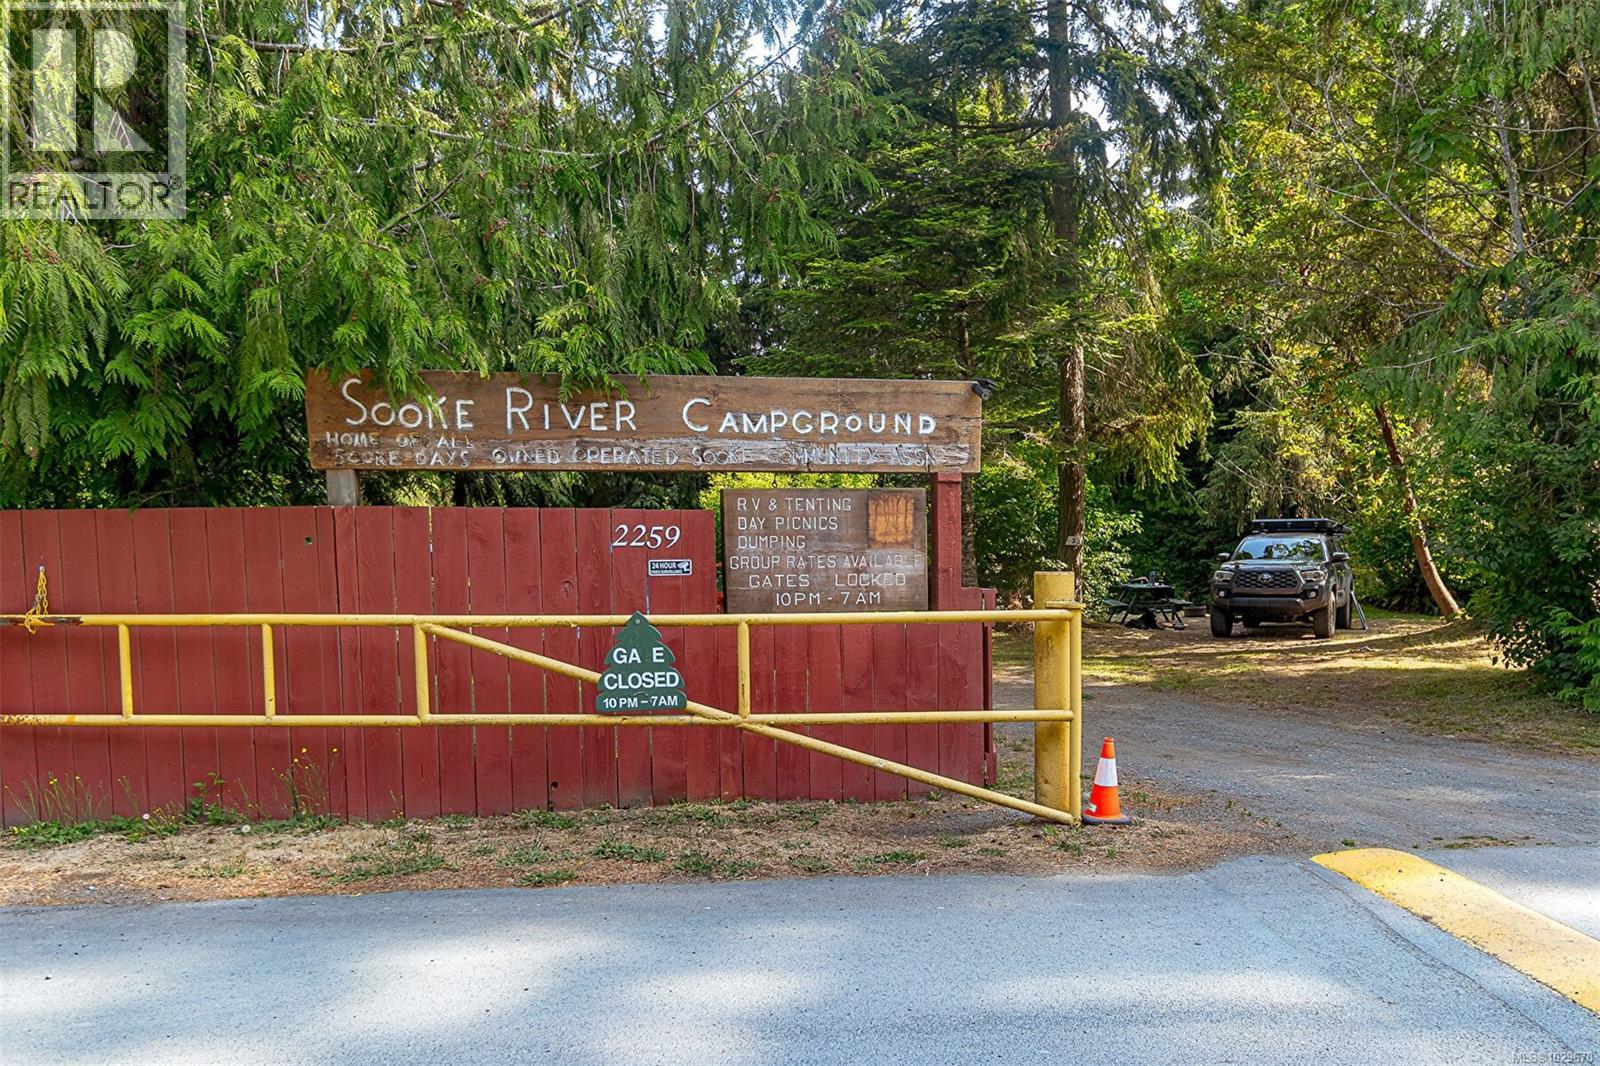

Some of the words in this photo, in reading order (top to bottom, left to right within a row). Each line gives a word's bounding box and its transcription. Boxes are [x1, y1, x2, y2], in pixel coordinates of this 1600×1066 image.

[506, 387, 637, 432] RIVER
[682, 398, 937, 435] CAMPGROUND
[325, 431, 380, 448] HOME
[416, 449, 471, 468] DAYS
[573, 447, 679, 466] OPERATED
[768, 498, 778, 511] &
[785, 498, 852, 511] TENTING
[738, 517, 771, 530] DAY
[775, 517, 839, 530] PICNICS
[611, 524, 682, 549] 2259
[738, 535, 806, 549] DUMPING
[660, 562, 677, 570] HOUR
[729, 556, 780, 570] GROUP
[787, 555, 837, 569] RATES
[842, 554, 924, 569] AVAILABLE
[749, 574, 810, 588] GATES
[834, 573, 906, 587] LOCKED
[612, 647, 665, 665] GAE
[603, 671, 680, 691] CLOSED
[650, 695, 678, 708] 7AM
